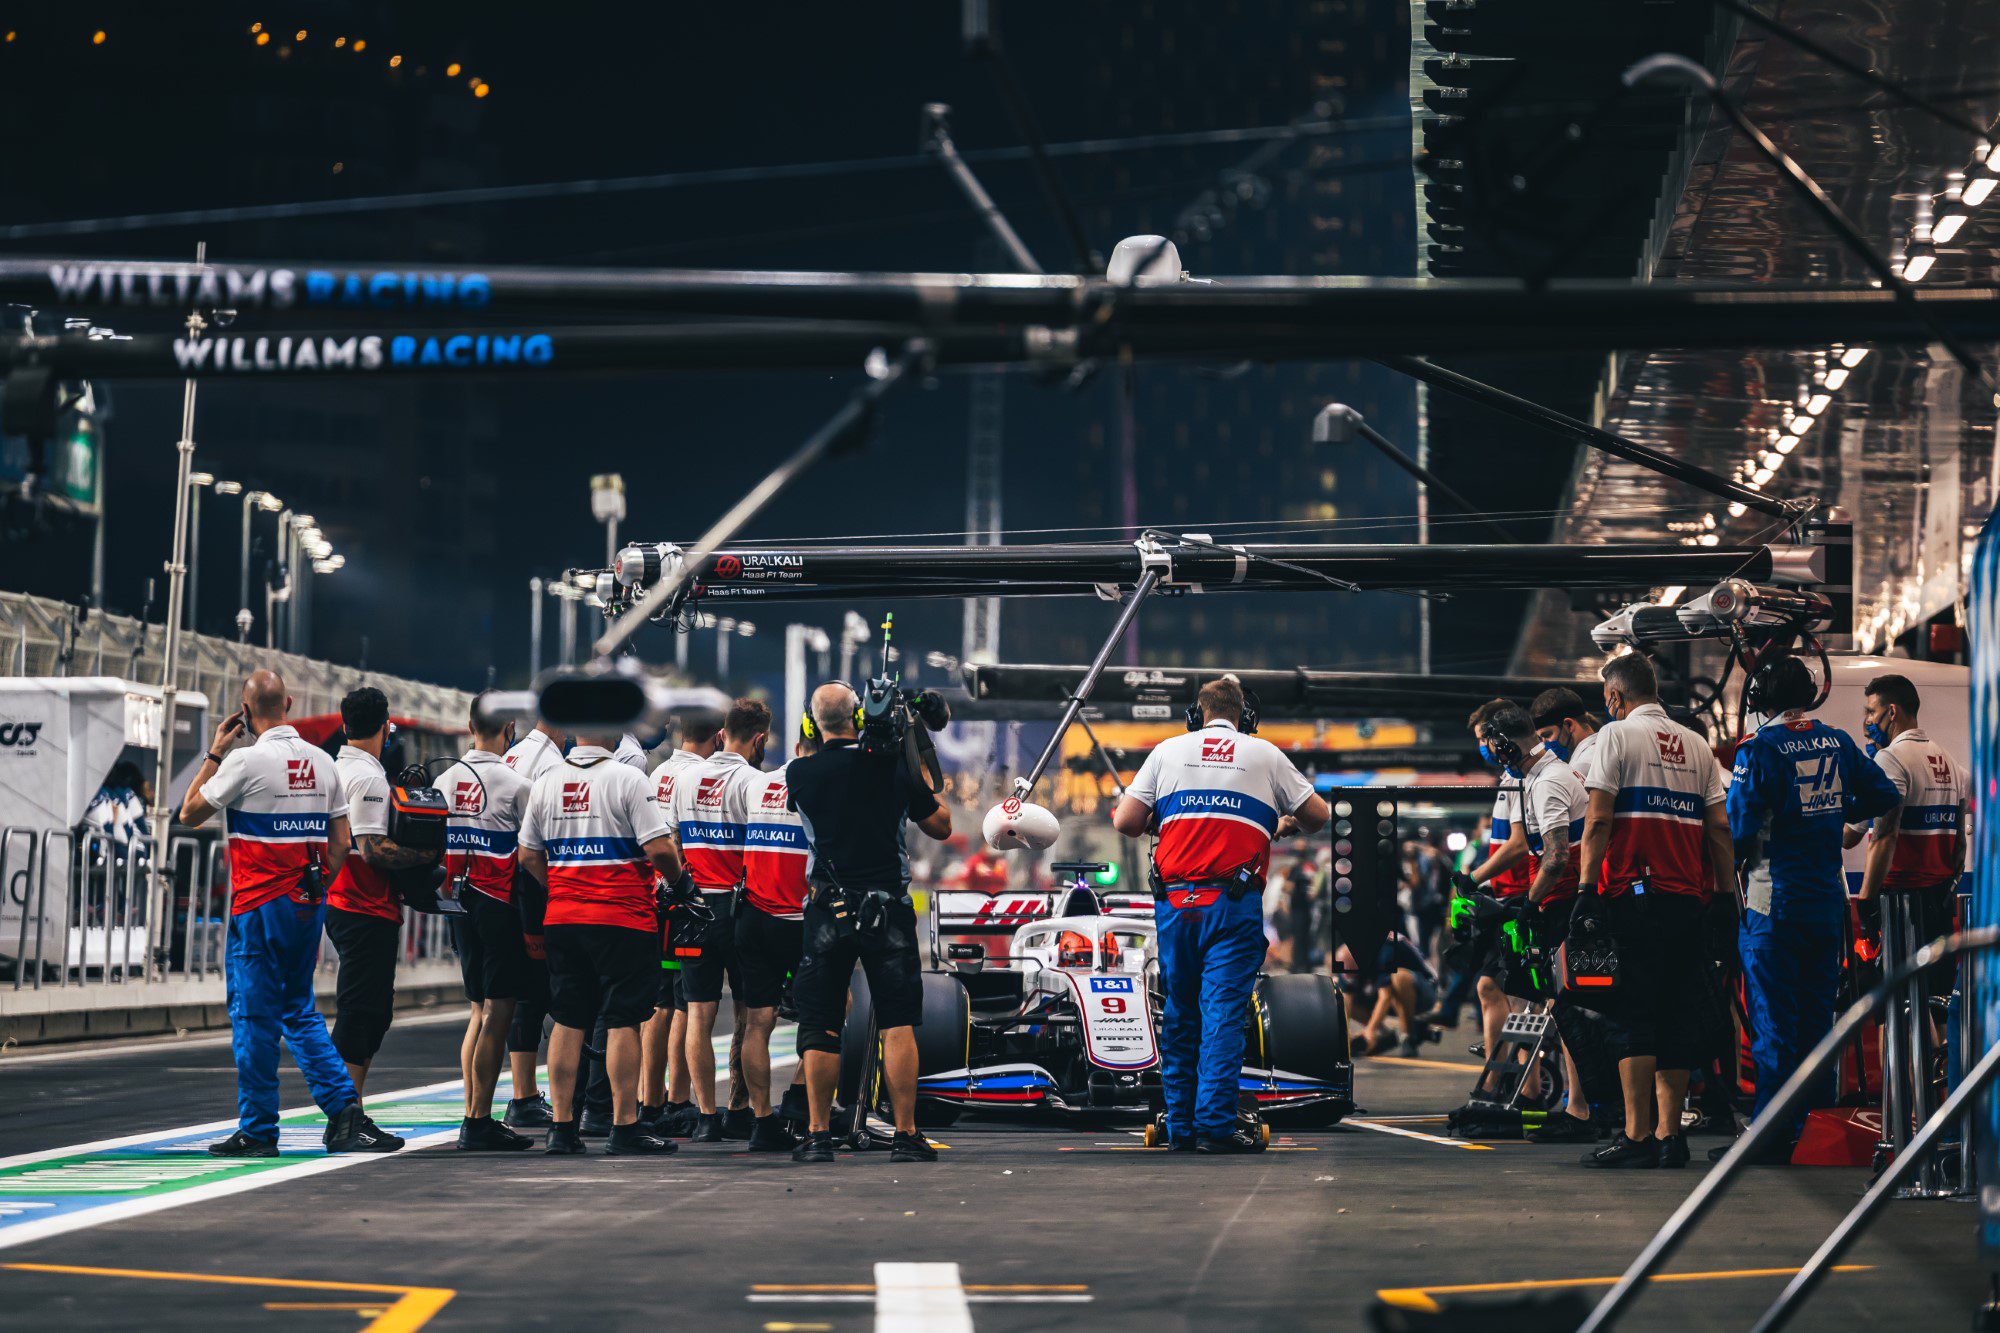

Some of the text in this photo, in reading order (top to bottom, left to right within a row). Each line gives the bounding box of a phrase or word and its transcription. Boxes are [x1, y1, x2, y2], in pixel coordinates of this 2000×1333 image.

[48, 264, 491, 304] WILLIAMS RACING
[173, 334, 554, 370] WILLIAMS RACING
[742, 555, 803, 566] URALKALI
[1777, 736, 1841, 755] URALKALI
[1202, 753, 1235, 762] HAAS
[289, 779, 316, 789] HAAS
[1180, 795, 1242, 810] URALKALI
[1801, 791, 1842, 810] HAAS
[563, 802, 589, 812] HAAS
[273, 820, 326, 831] URALKALI
[688, 827, 735, 839] URALKALI
[747, 829, 796, 842] URALKALI
[448, 833, 491, 847] RALKALI
[553, 844, 604, 856] URALKALI
[1093, 979, 1129, 990] 1&1
[1101, 997, 1127, 1014] 9
